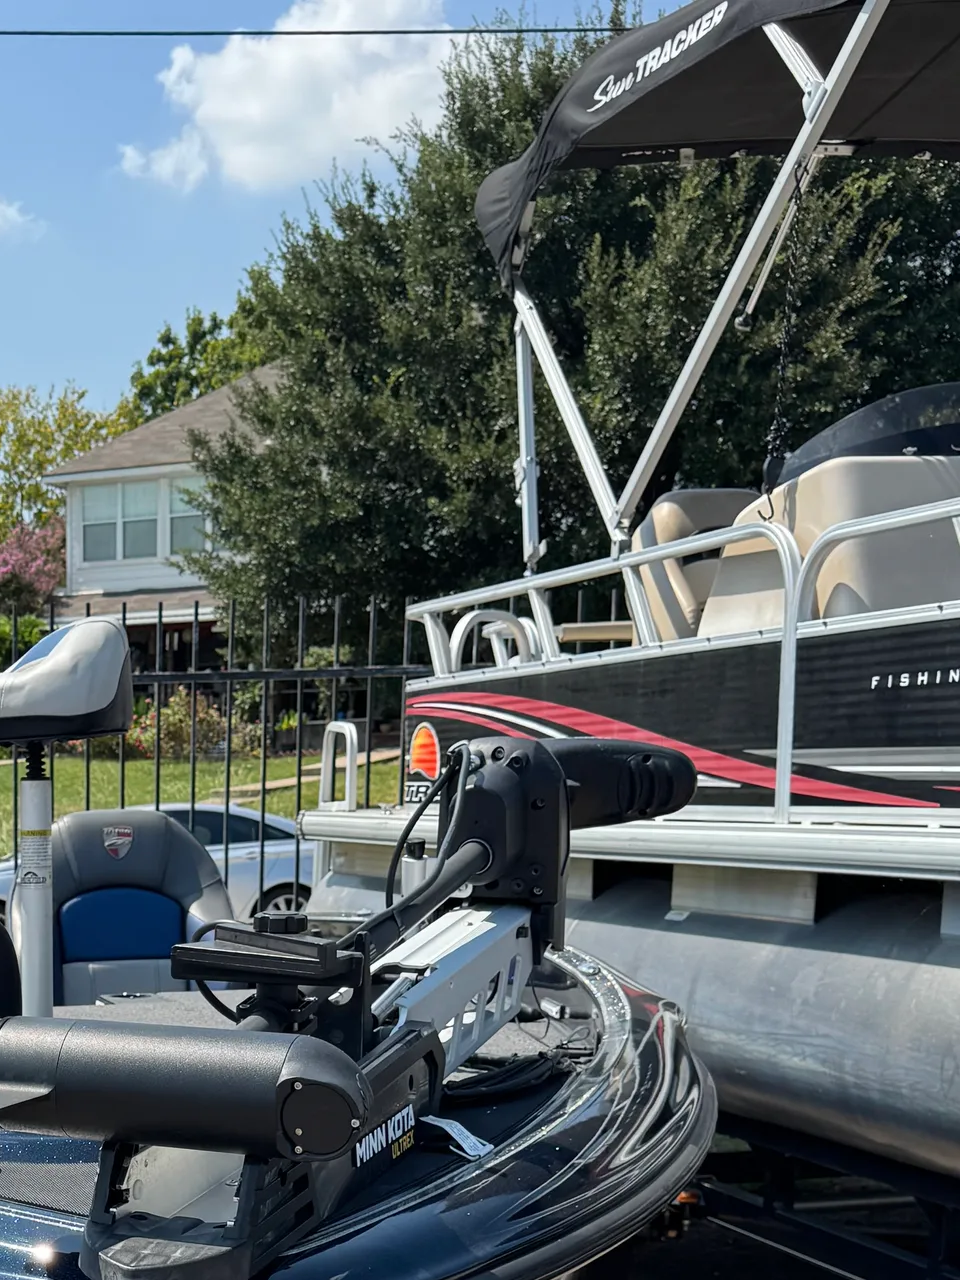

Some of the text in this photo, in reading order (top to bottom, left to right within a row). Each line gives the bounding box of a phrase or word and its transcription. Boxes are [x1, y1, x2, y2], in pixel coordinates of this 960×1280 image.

[586, 1, 728, 112] Sun TRACKER
[355, 1122, 387, 1168] MINN
[387, 1103, 415, 1144] KOTA
[391, 1129, 415, 1160] ULTREX
